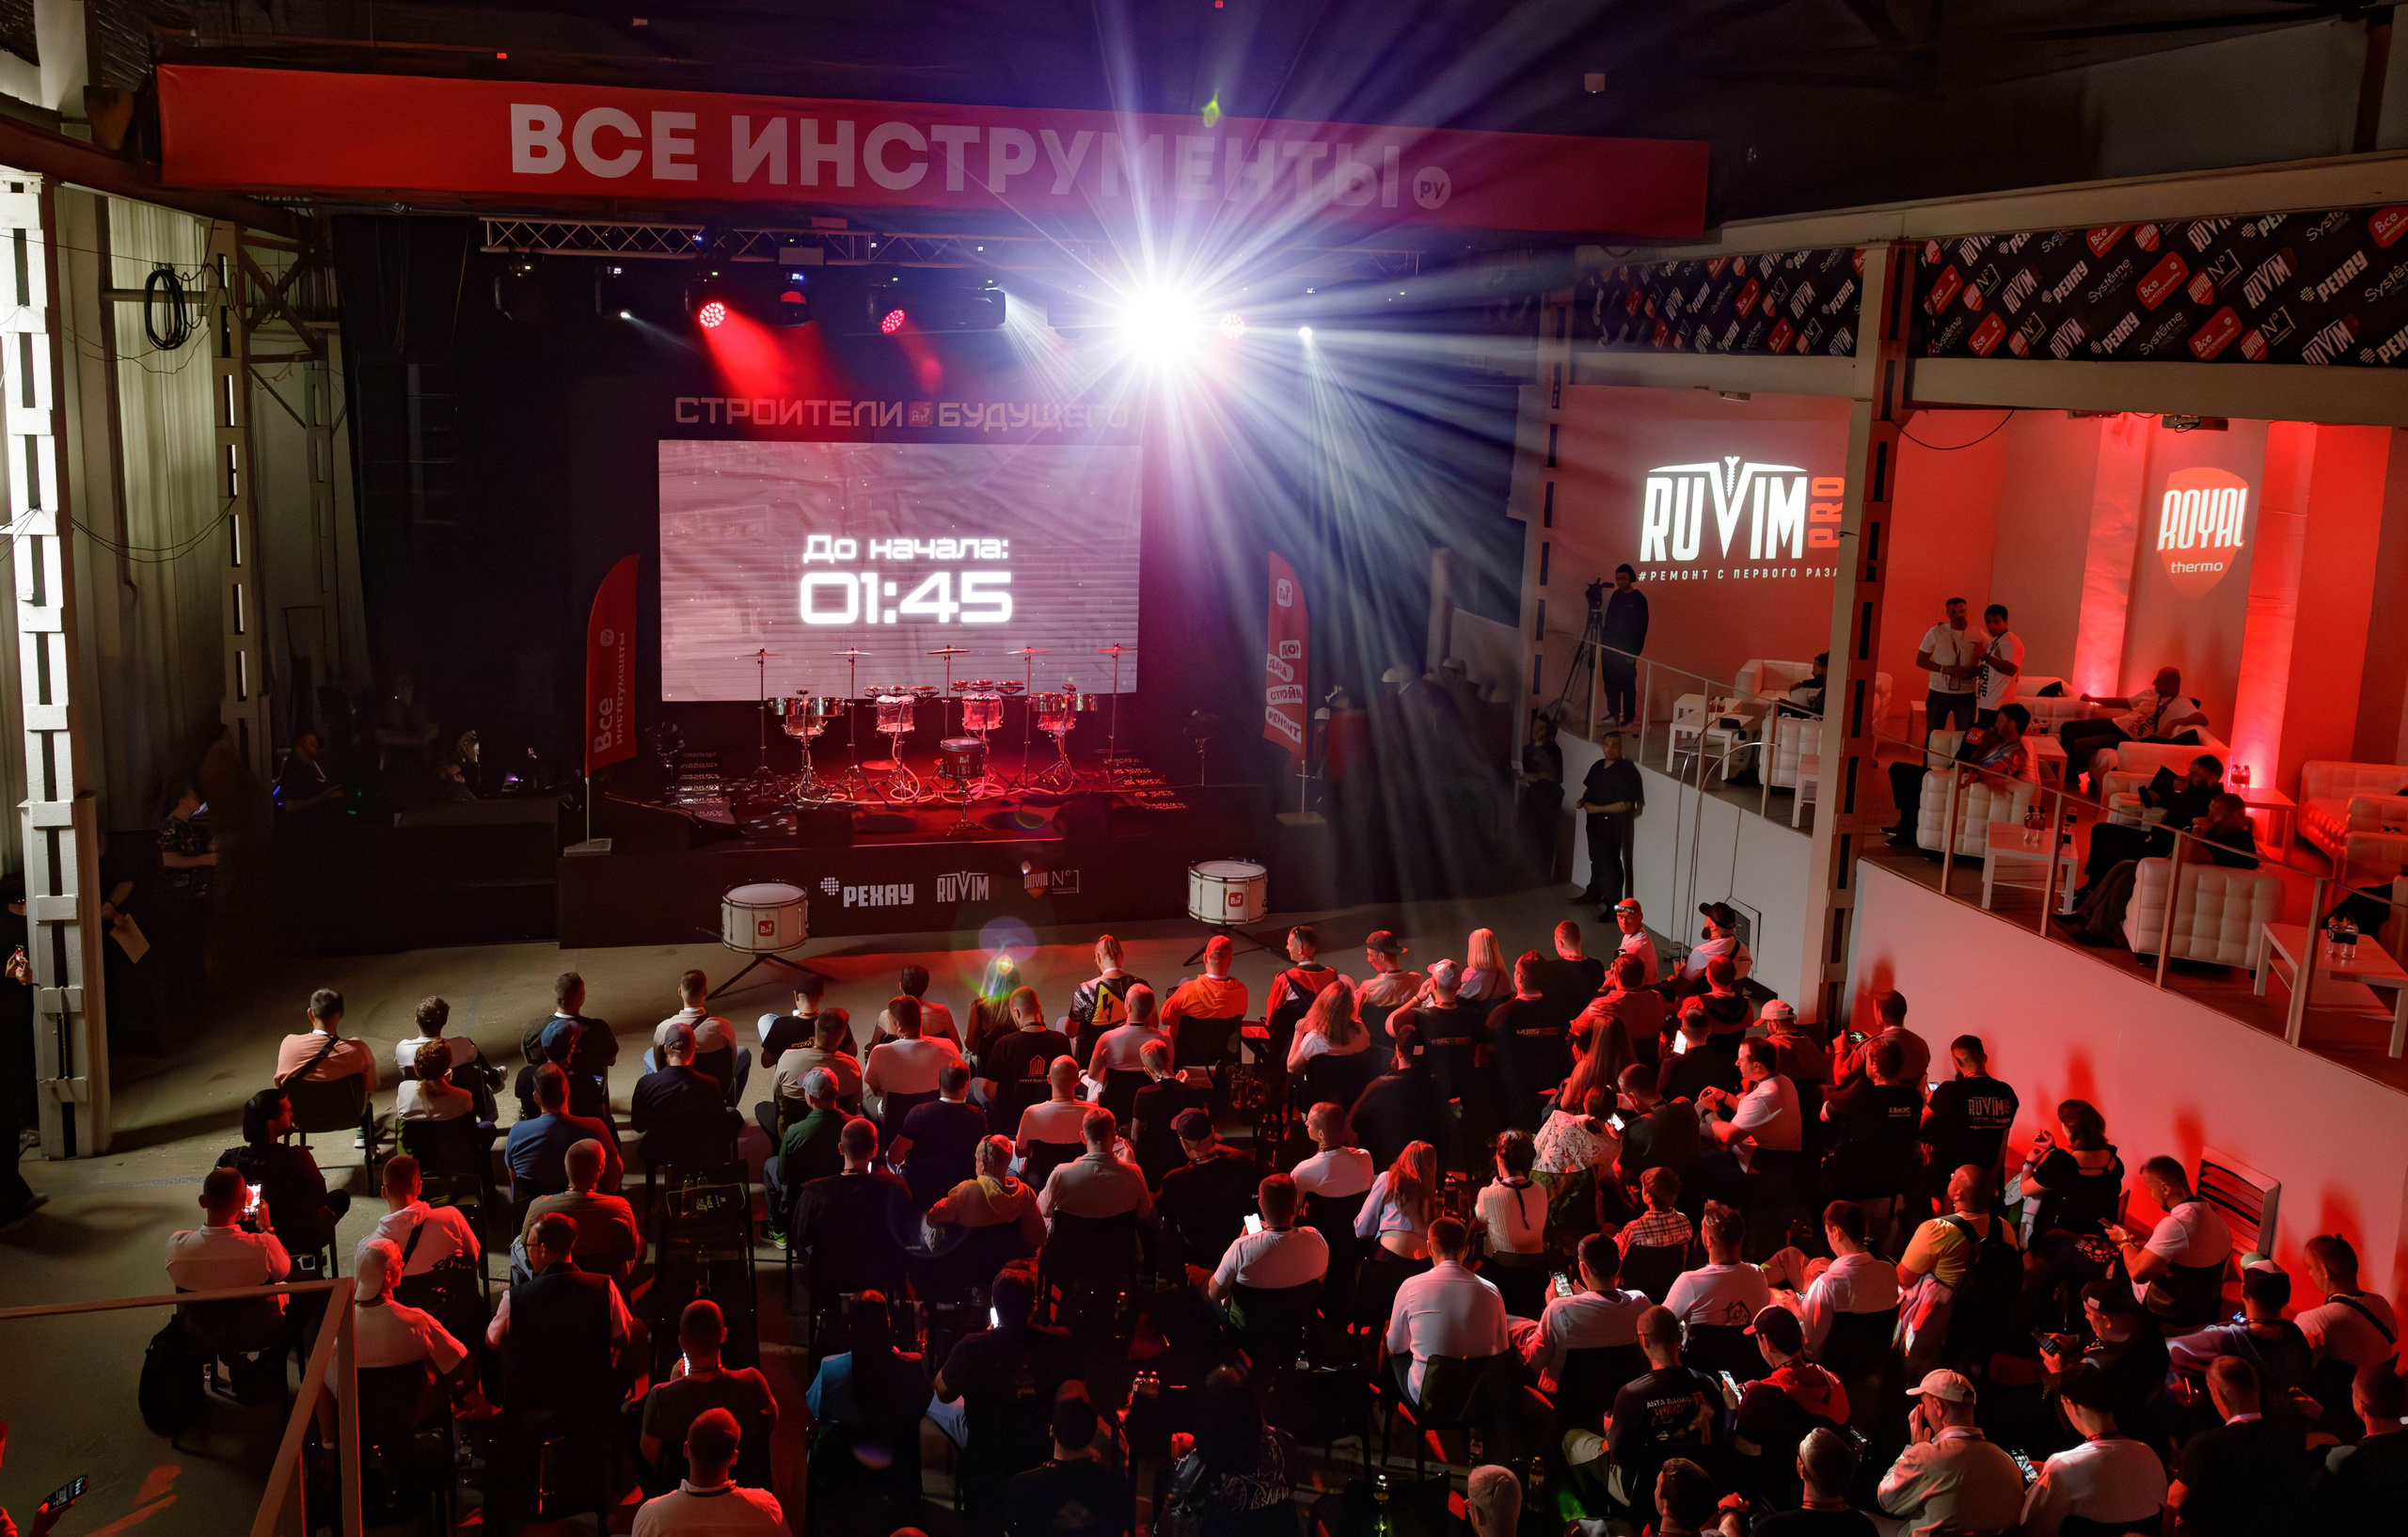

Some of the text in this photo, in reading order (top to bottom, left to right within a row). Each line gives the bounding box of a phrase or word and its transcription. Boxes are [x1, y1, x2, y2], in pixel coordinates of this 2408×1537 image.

[510, 102, 1400, 208] ВСЕ ИНСТРУМЕНТЫ
[2374, 212, 2400, 234] Все
[2140, 279, 2160, 298] Все
[2242, 251, 2292, 310] RUVIM
[2194, 333, 2213, 354] Все
[674, 396, 903, 428] СТРОИТЕЛИ
[1640, 456, 1808, 563] RUVIM
[1808, 477, 1846, 548] PRO
[2157, 487, 2247, 551] ROYAL
[802, 534, 1009, 563] До начала:
[1639, 569, 1709, 581] #РЕМОНТ
[1718, 569, 1724, 579] С
[1734, 567, 1797, 579] ПЕРВОГО
[2171, 562, 2224, 574] thermo
[800, 571, 1013, 624] 01:45
[594, 697, 613, 753] Все
[937, 871, 990, 903] RUVIM
